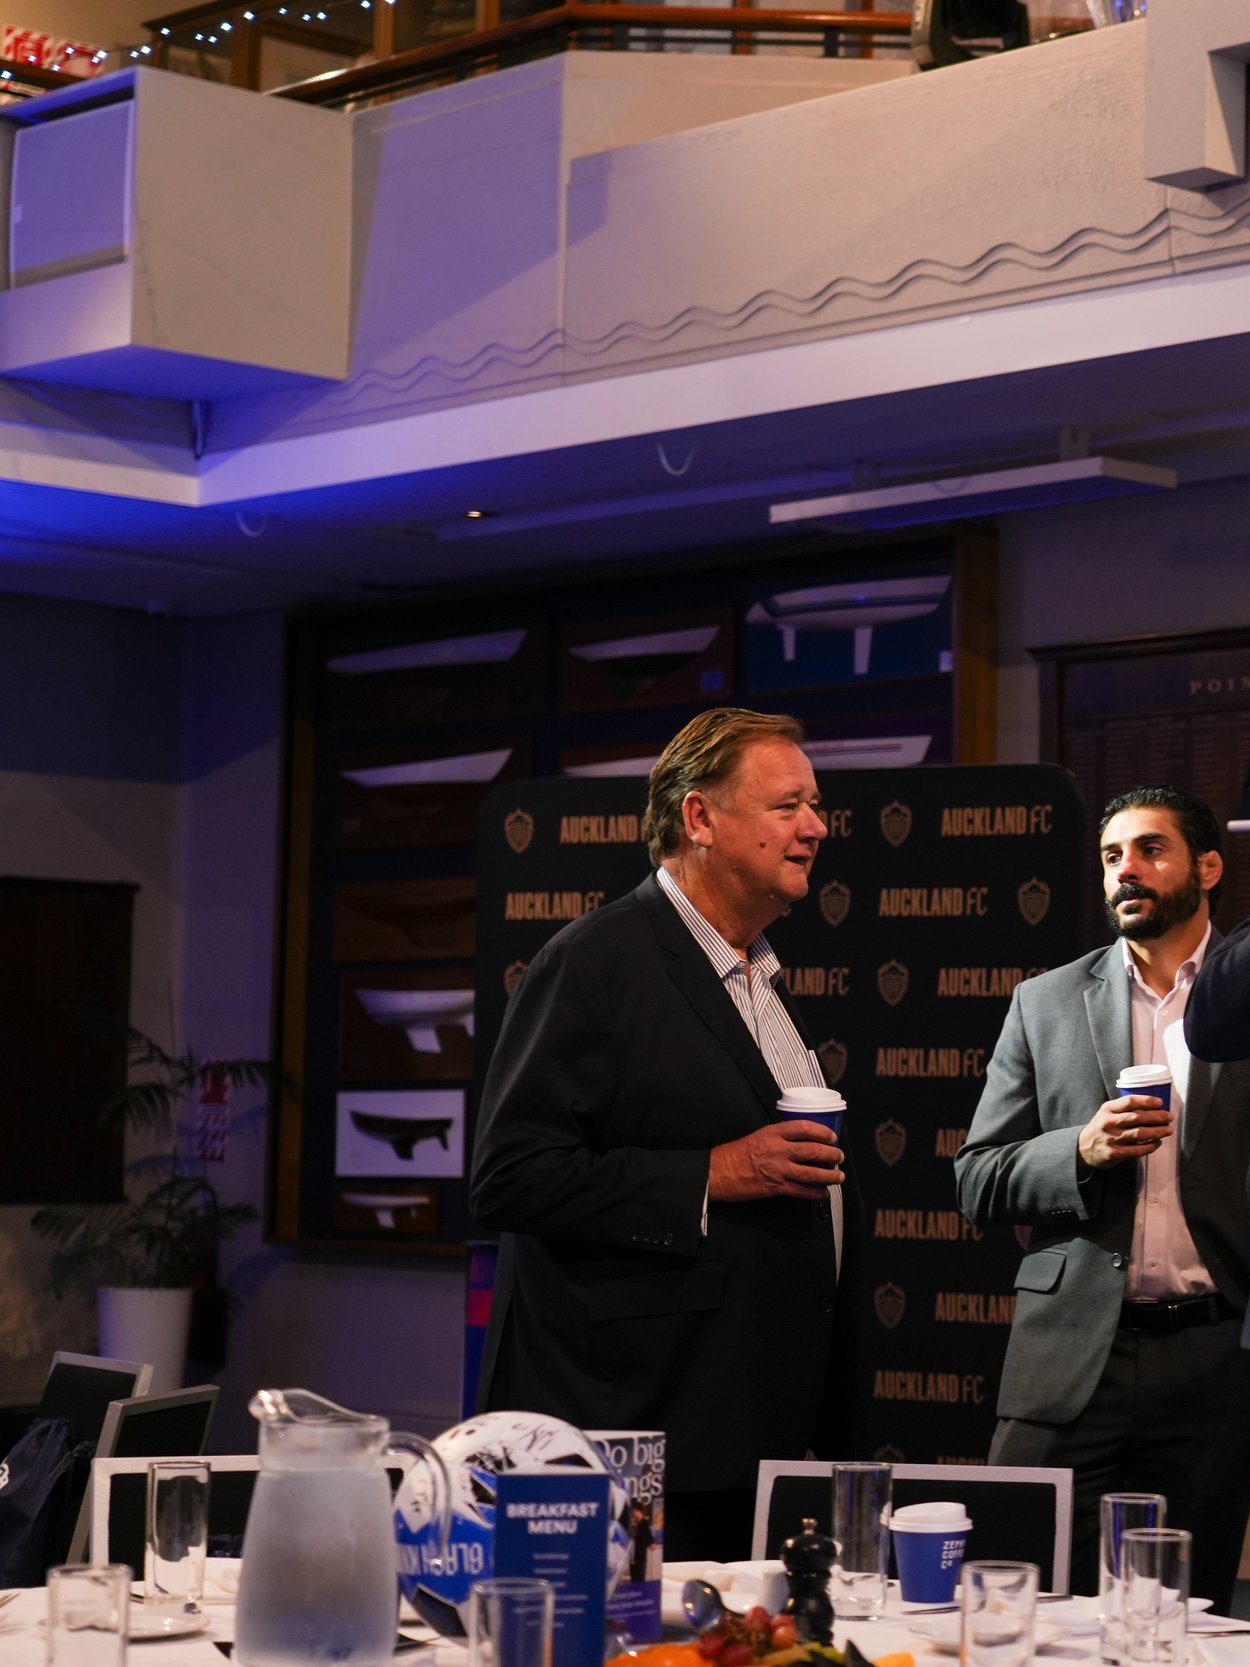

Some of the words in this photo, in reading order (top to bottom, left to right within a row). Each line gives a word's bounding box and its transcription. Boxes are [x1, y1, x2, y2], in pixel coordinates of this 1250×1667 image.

[559, 814, 639, 844] AUCKLAND
[830, 809, 853, 838] FC
[940, 806, 1027, 837] AUCKLAND
[1029, 804, 1052, 835] FC
[504, 891, 583, 921] AUCKLAND
[878, 887, 964, 918] AUCKLAND
[965, 886, 988, 917] FC
[781, 966, 825, 997] LAND
[828, 966, 849, 997] FC
[875, 1047, 960, 1078] AUCKLAND
[962, 1048, 985, 1078] FC
[873, 1208, 959, 1240] AUCKLAND
[873, 1370, 959, 1404] AUCKLAND
[961, 1375, 985, 1405] FC
[632, 1436, 667, 1473] big
[506, 1502, 600, 1519] BREAKFAST
[527, 1519, 579, 1535] MENU
